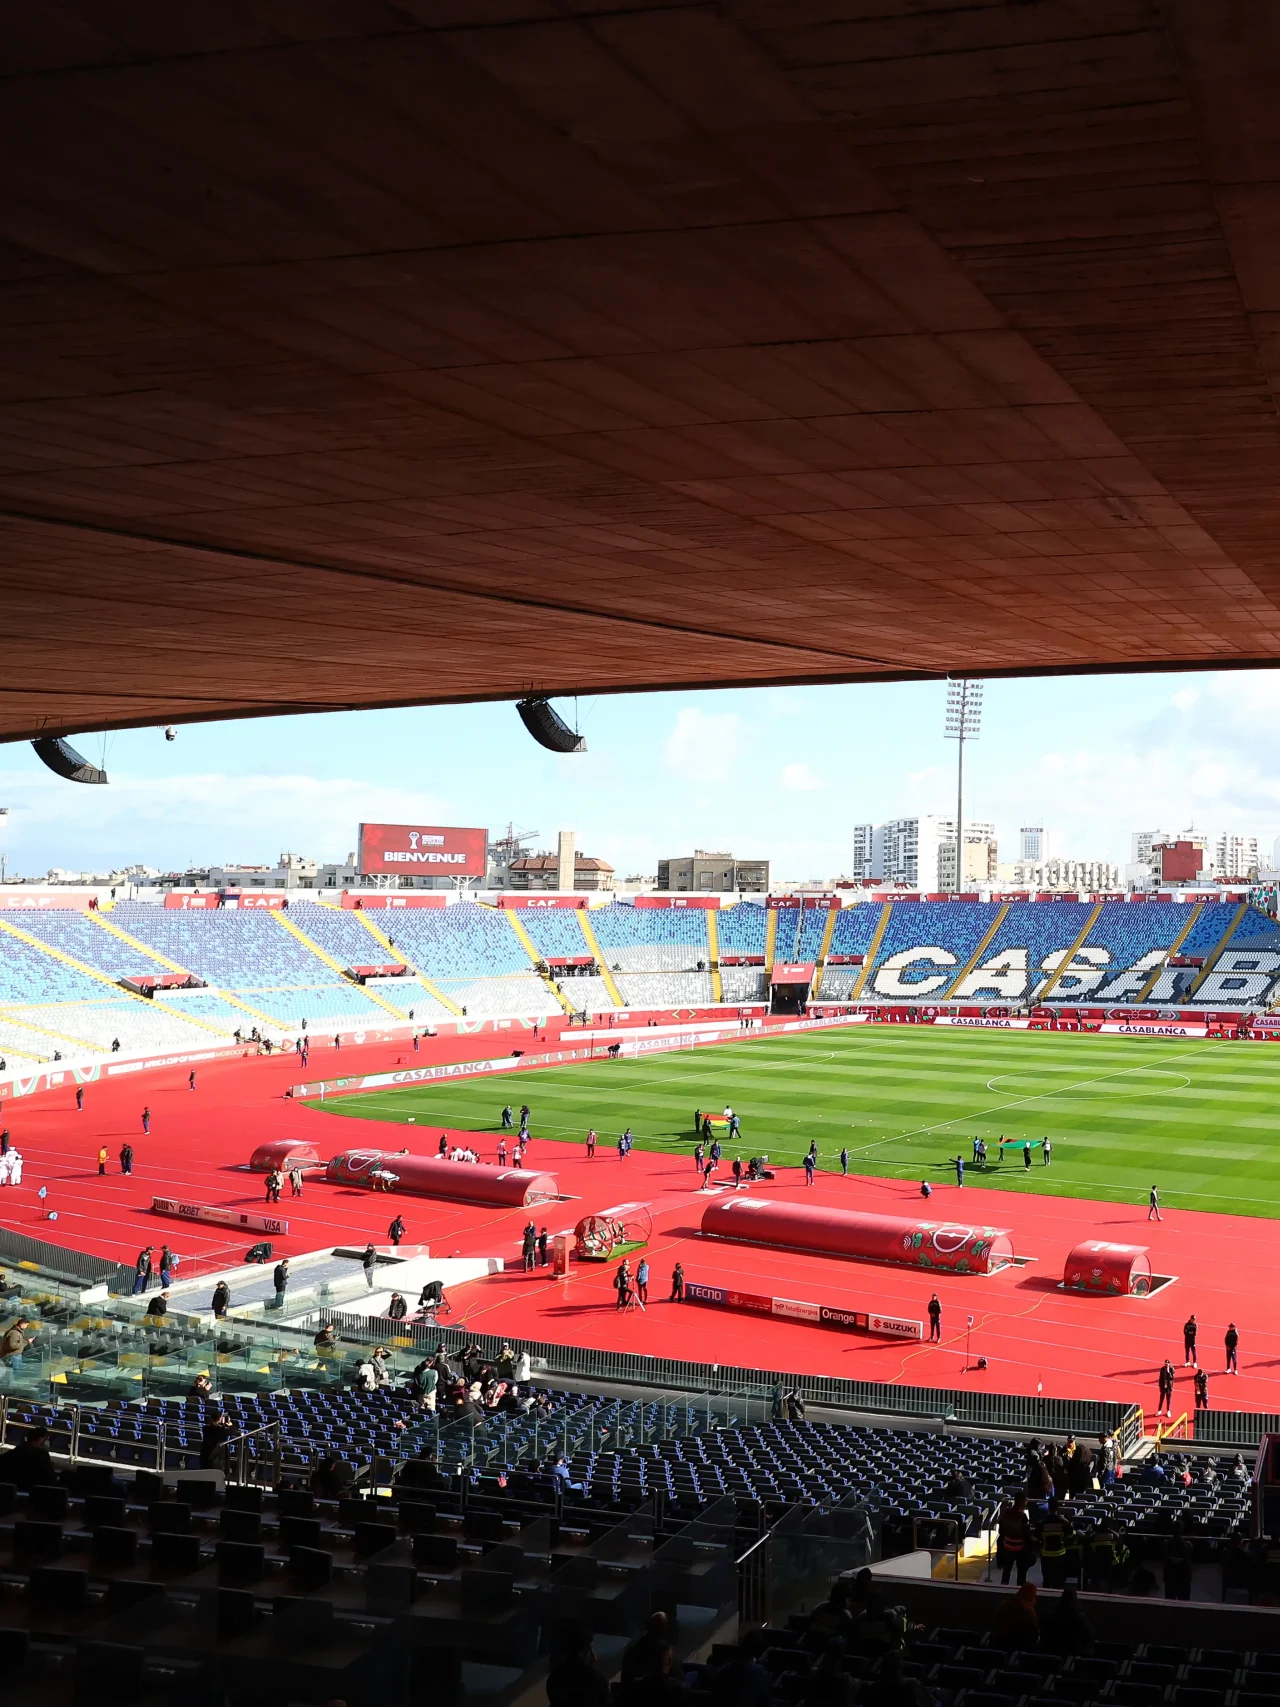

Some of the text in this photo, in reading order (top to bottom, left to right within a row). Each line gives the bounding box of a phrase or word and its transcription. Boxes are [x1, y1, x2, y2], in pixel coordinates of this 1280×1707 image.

[384, 851, 466, 864] BIENVENUE
[7, 897, 51, 907] CAF
[243, 898, 279, 907] CAF
[527, 899, 557, 907] CAF
[799, 1016, 848, 1028] CASABLANCA
[951, 1017, 1011, 1027] CASABLANCA
[1119, 1025, 1187, 1035] CASABLANCA
[632, 1034, 700, 1050] CASABLANCA
[392, 1061, 493, 1083] CASABLANCA
[263, 1218, 281, 1233] VISA
[690, 1286, 722, 1301] TECNO
[822, 1308, 855, 1324] Orange
[882, 1321, 917, 1334] SUZUKI
